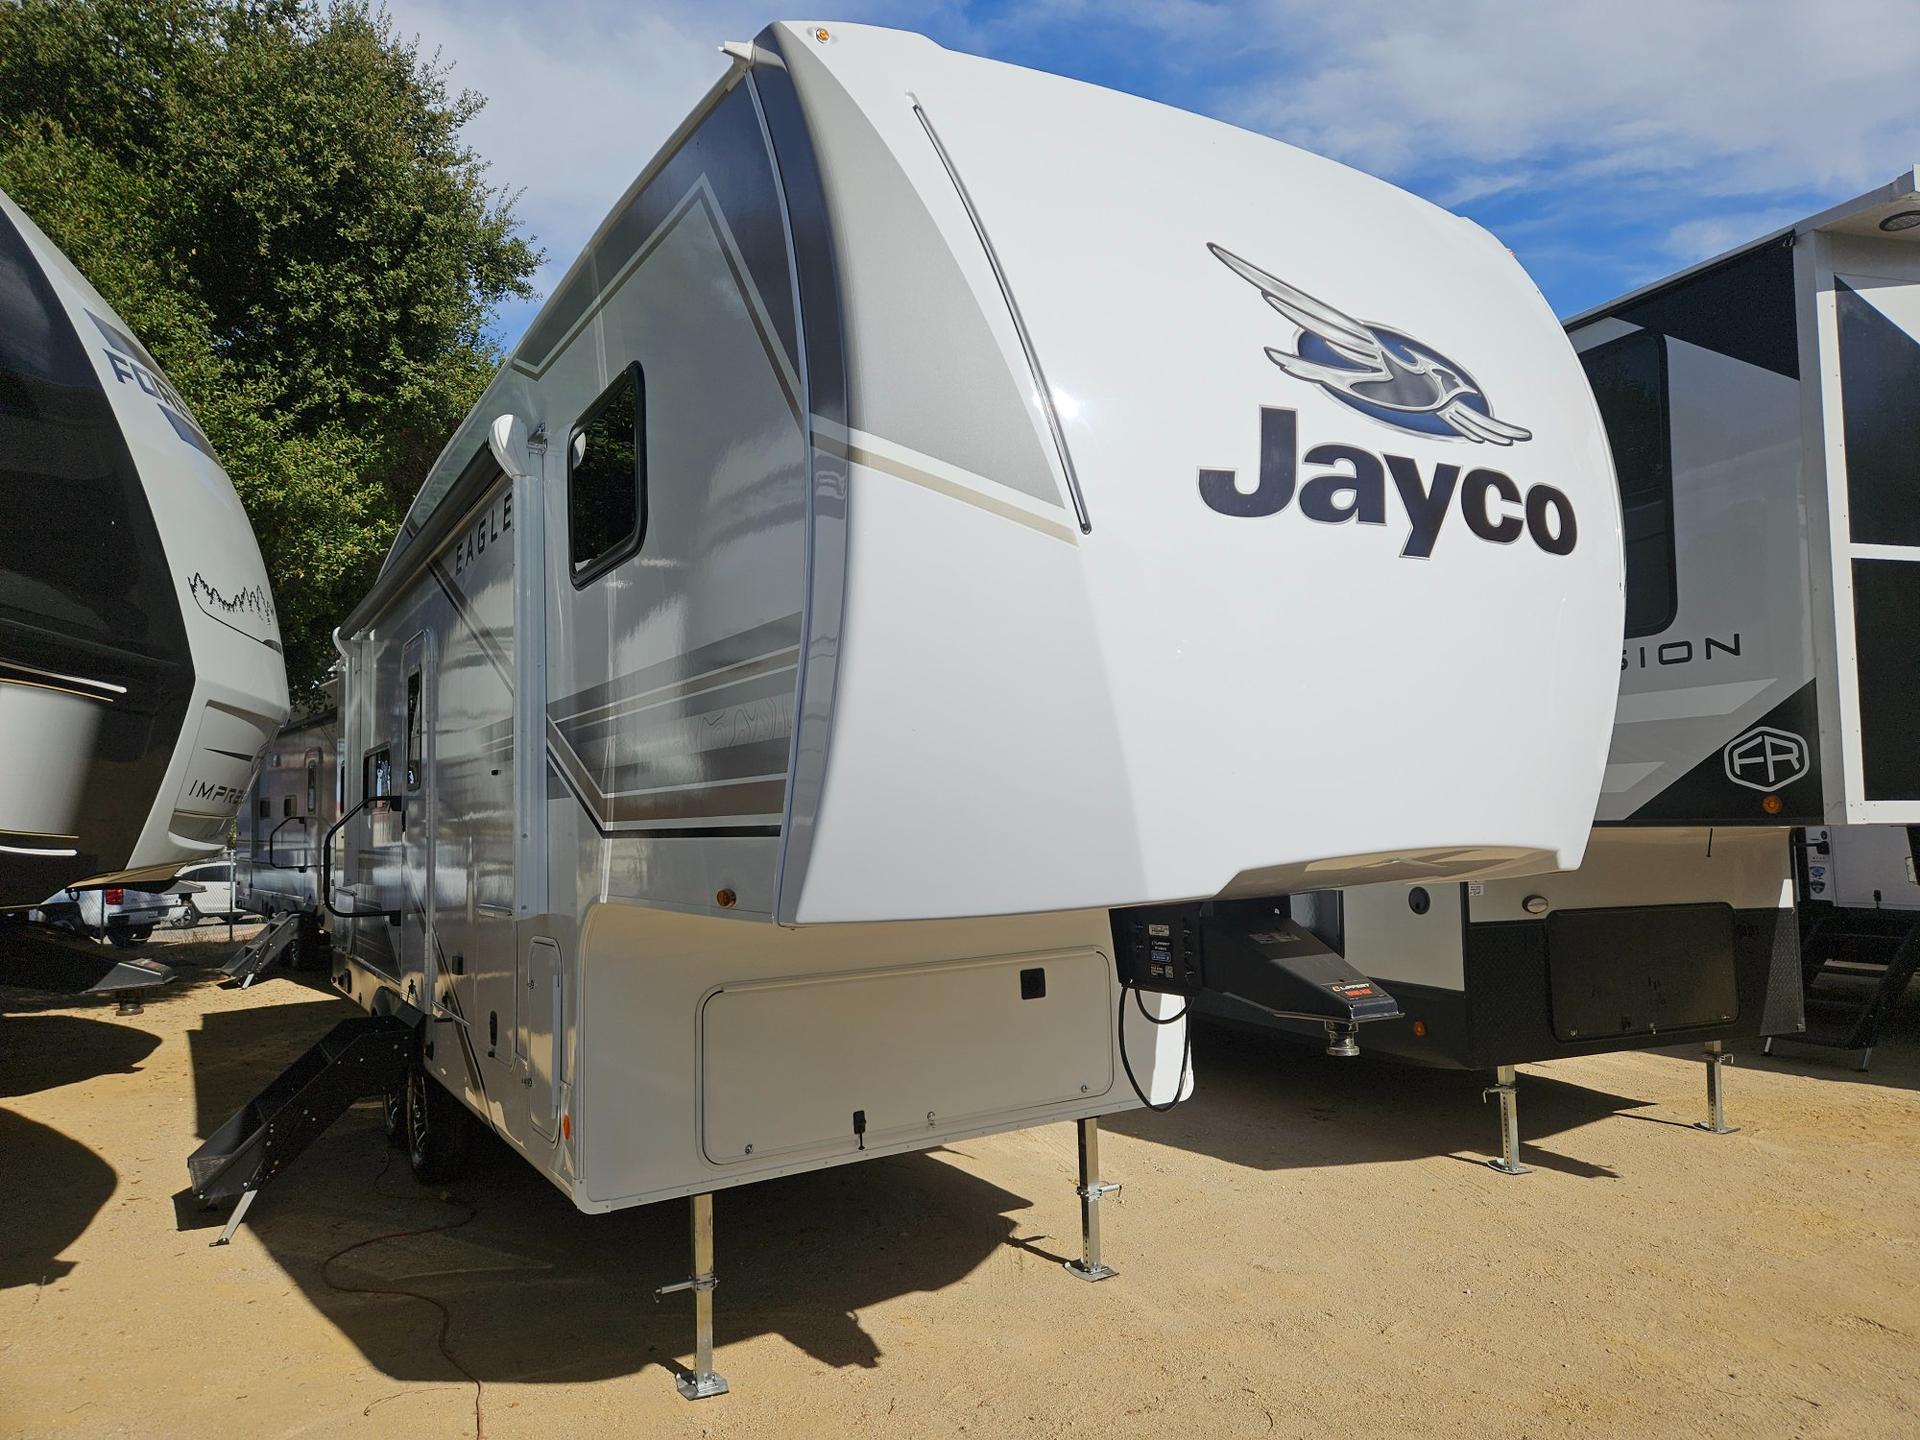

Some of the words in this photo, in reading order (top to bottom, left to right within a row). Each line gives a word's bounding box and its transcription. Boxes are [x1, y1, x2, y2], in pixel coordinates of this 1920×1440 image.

[1198, 404, 1578, 561] Jayco
[456, 492, 513, 576] EAGLE
[1732, 734, 1801, 783] FR
